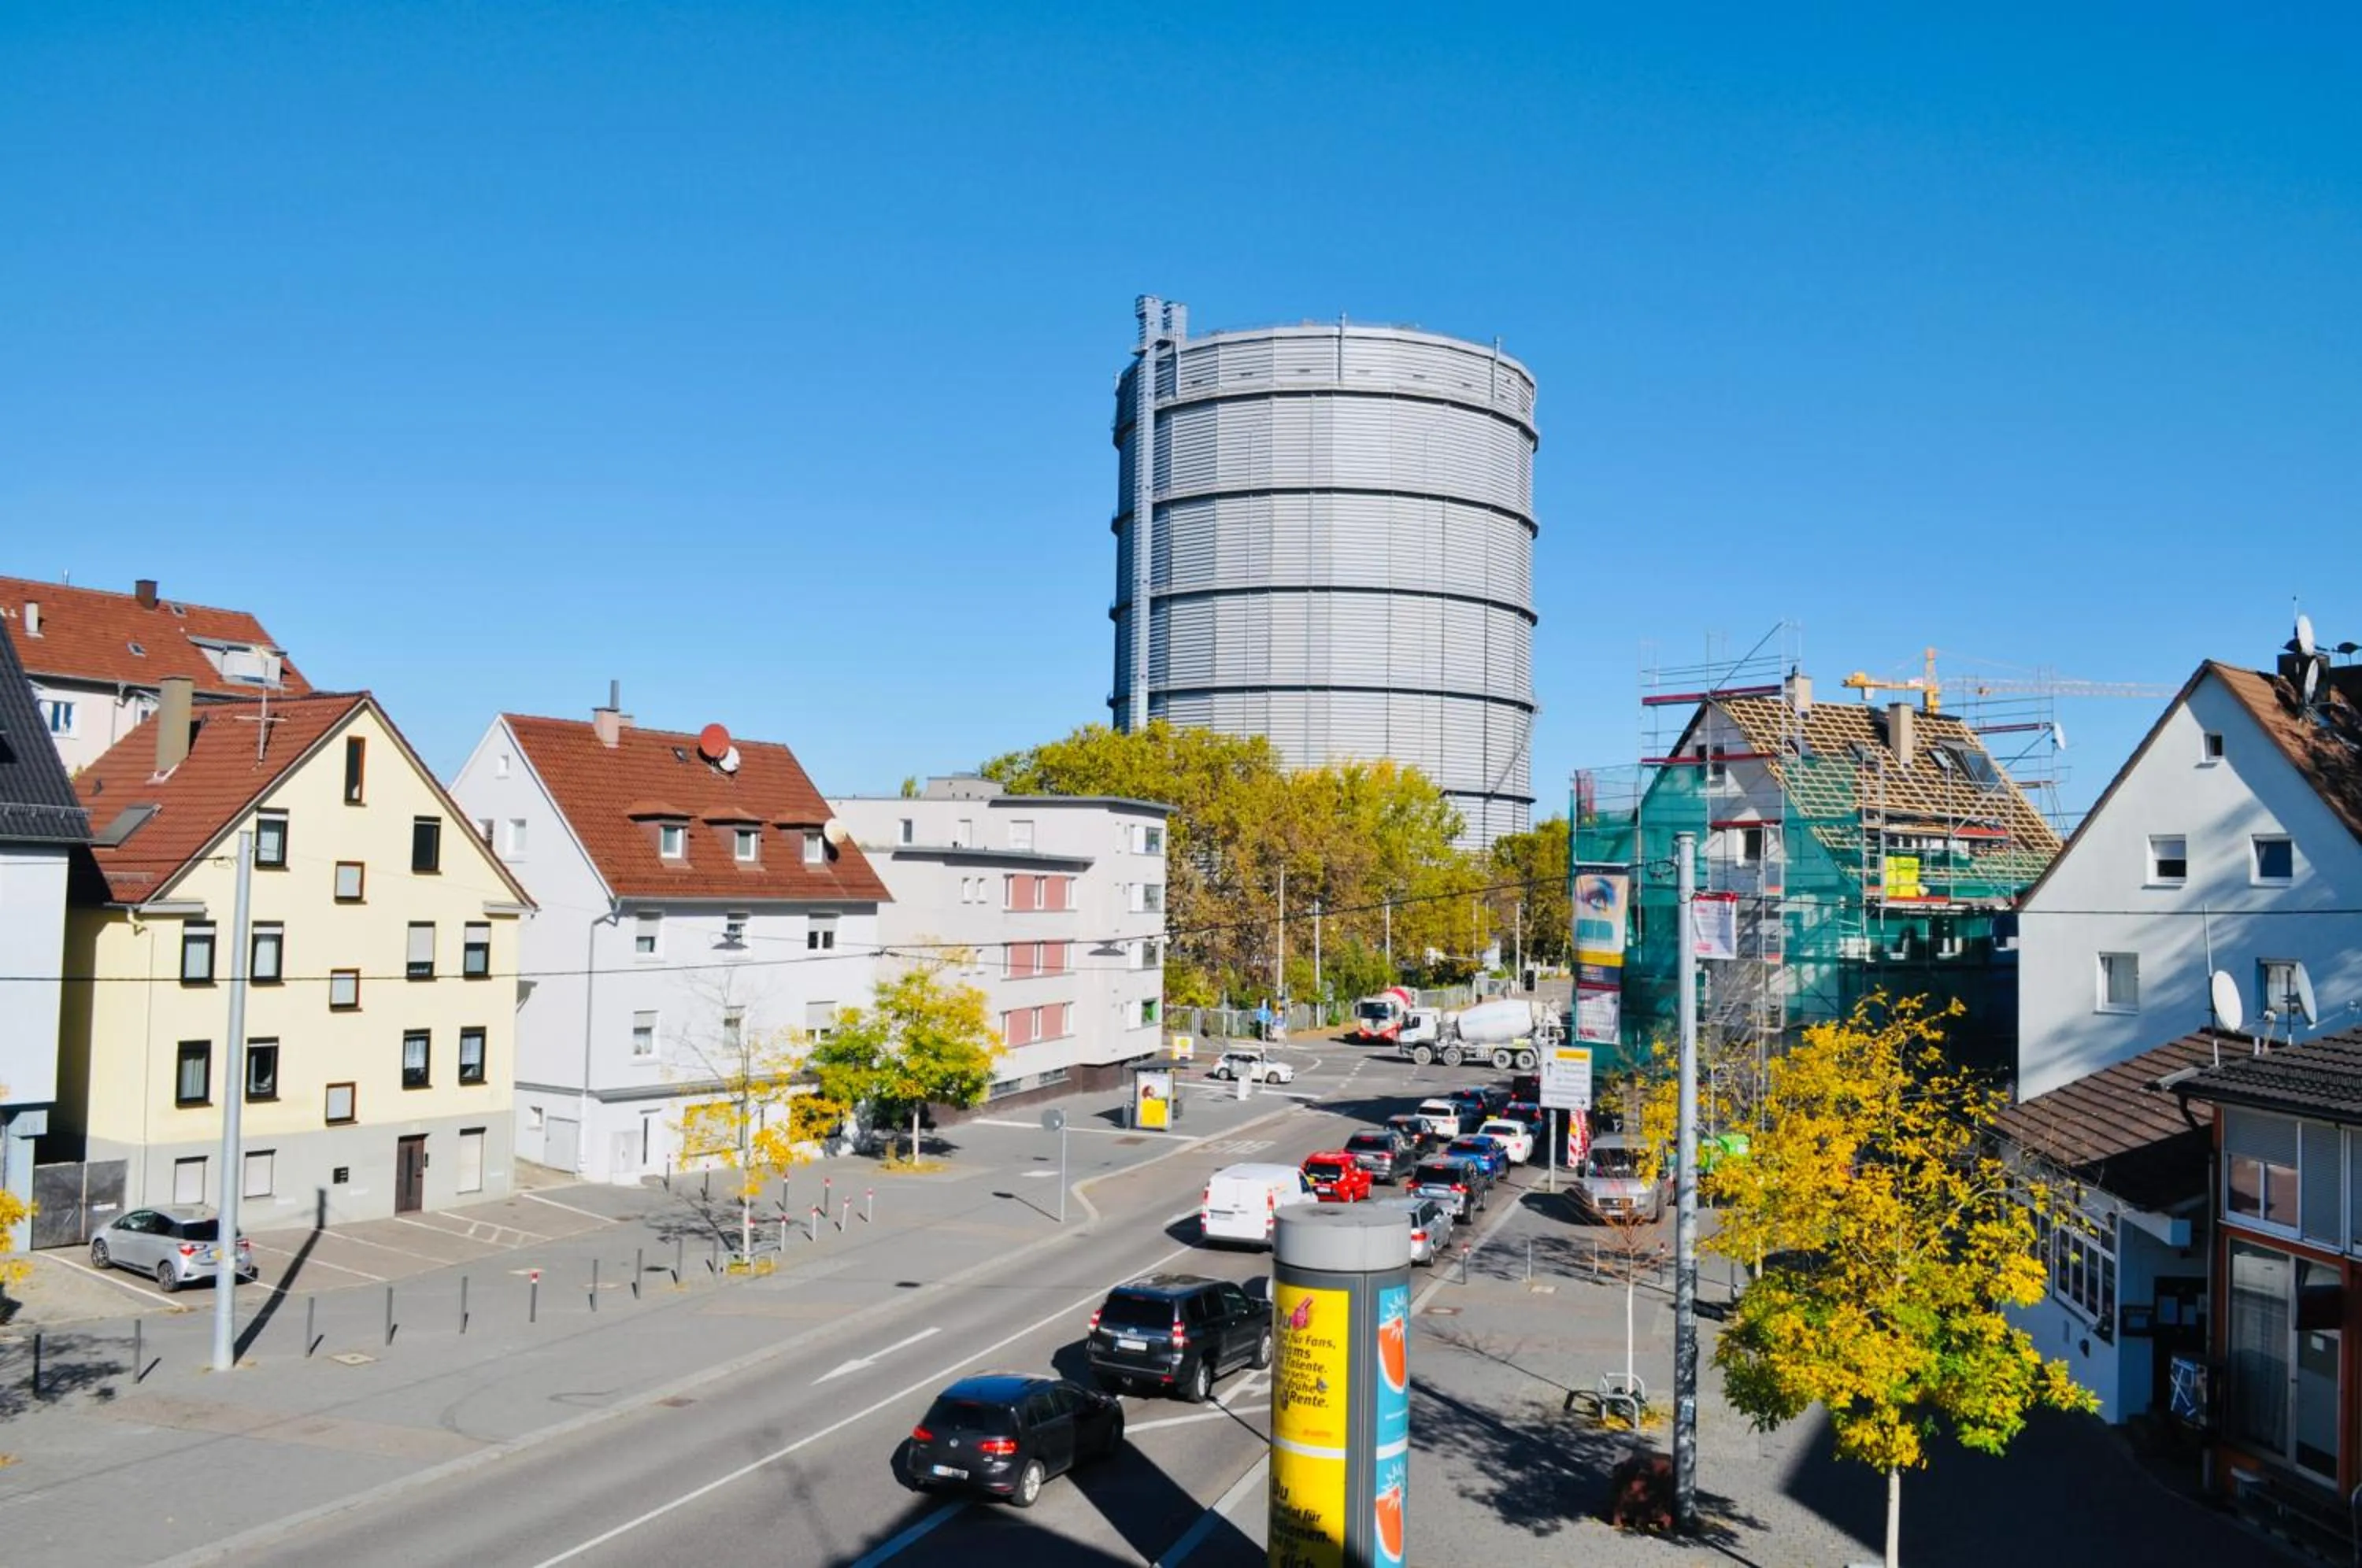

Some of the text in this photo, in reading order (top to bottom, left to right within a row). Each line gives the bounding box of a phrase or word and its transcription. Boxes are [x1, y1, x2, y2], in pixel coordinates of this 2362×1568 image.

[1305, 1335, 1336, 1350] Fans,
[1286, 1357, 1328, 1374] Talente.
[1290, 1391, 1330, 1409] Rente.
